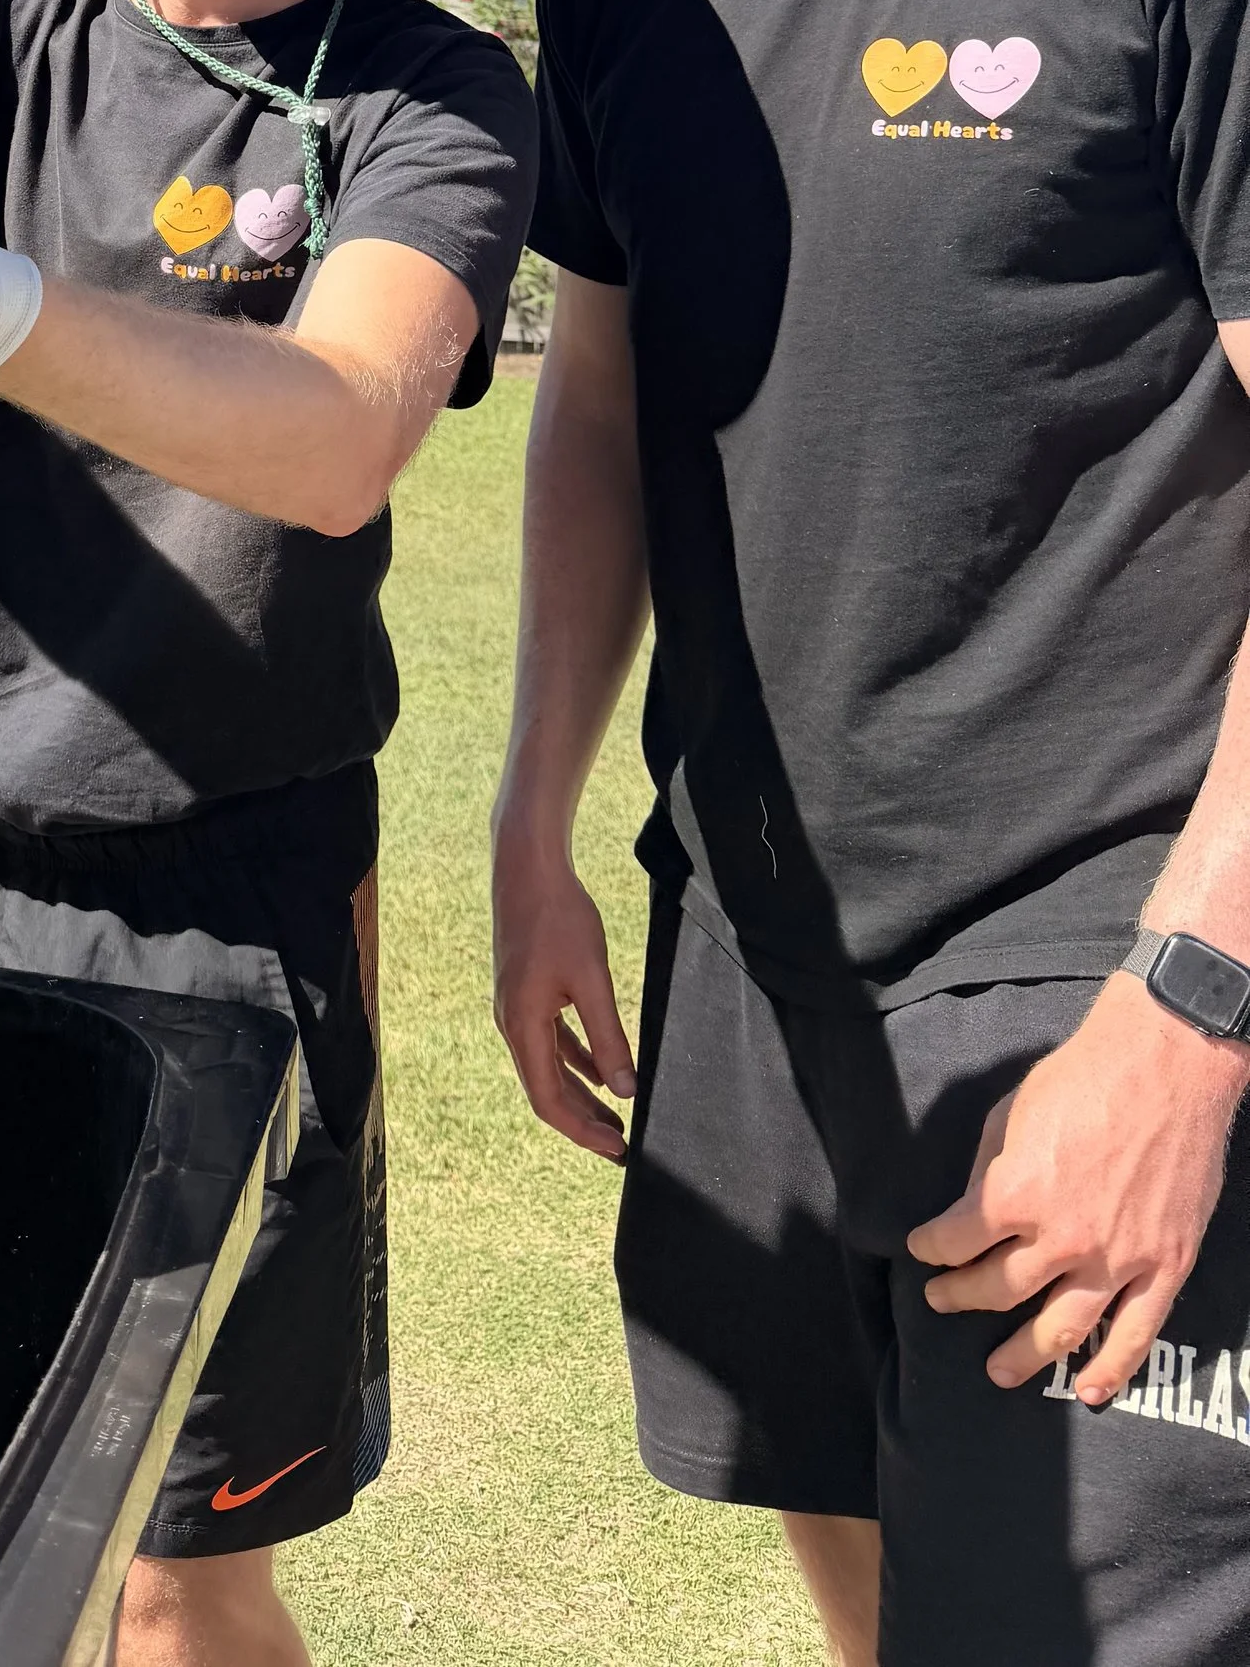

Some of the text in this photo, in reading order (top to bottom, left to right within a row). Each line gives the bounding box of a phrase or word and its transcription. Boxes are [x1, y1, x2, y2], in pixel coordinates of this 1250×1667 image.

[871, 119, 1013, 141] Equal Hearts
[160, 256, 296, 283] Equal Hearts
